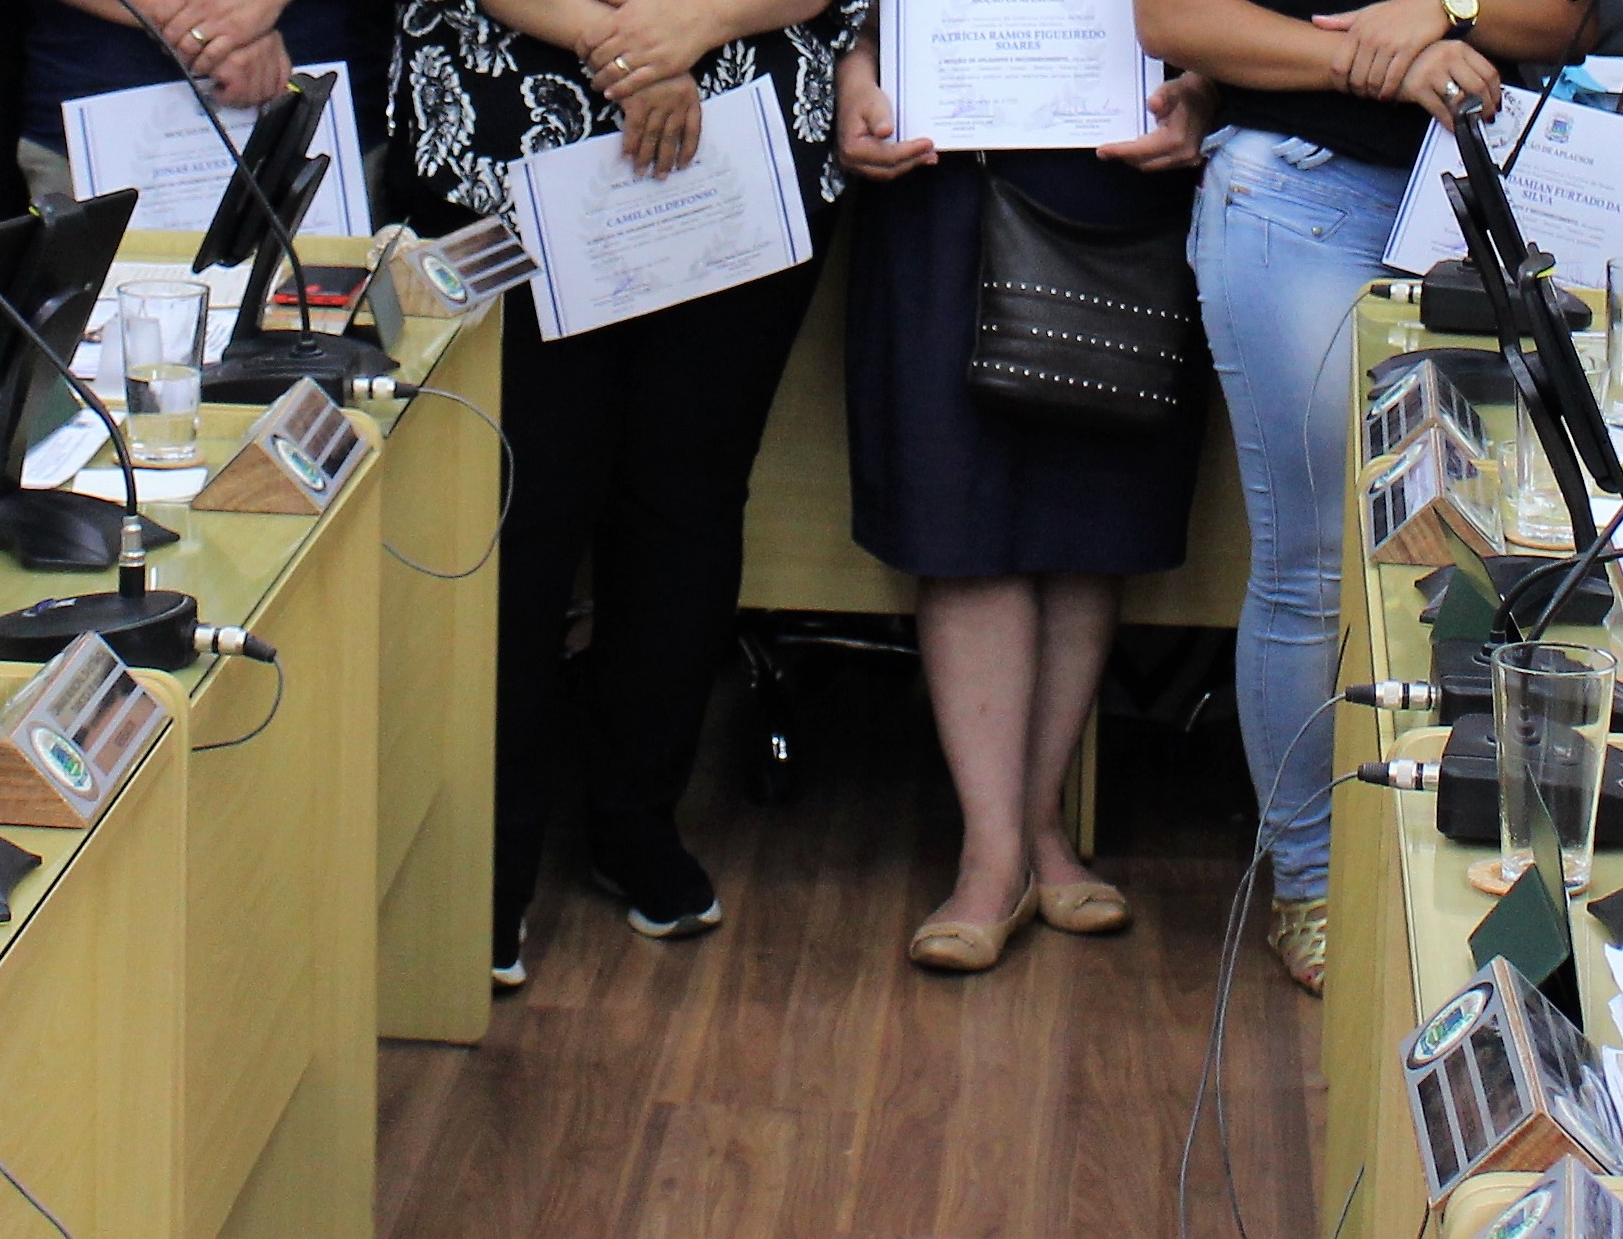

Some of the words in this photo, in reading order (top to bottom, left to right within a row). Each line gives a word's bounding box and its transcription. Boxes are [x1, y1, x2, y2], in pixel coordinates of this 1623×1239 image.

[931, 31, 986, 43] PATRÍCIA
[989, 30, 1032, 41] RAMOS
[1034, 29, 1106, 40] FIGUEIREDO
[995, 41, 1042, 50] SOARES
